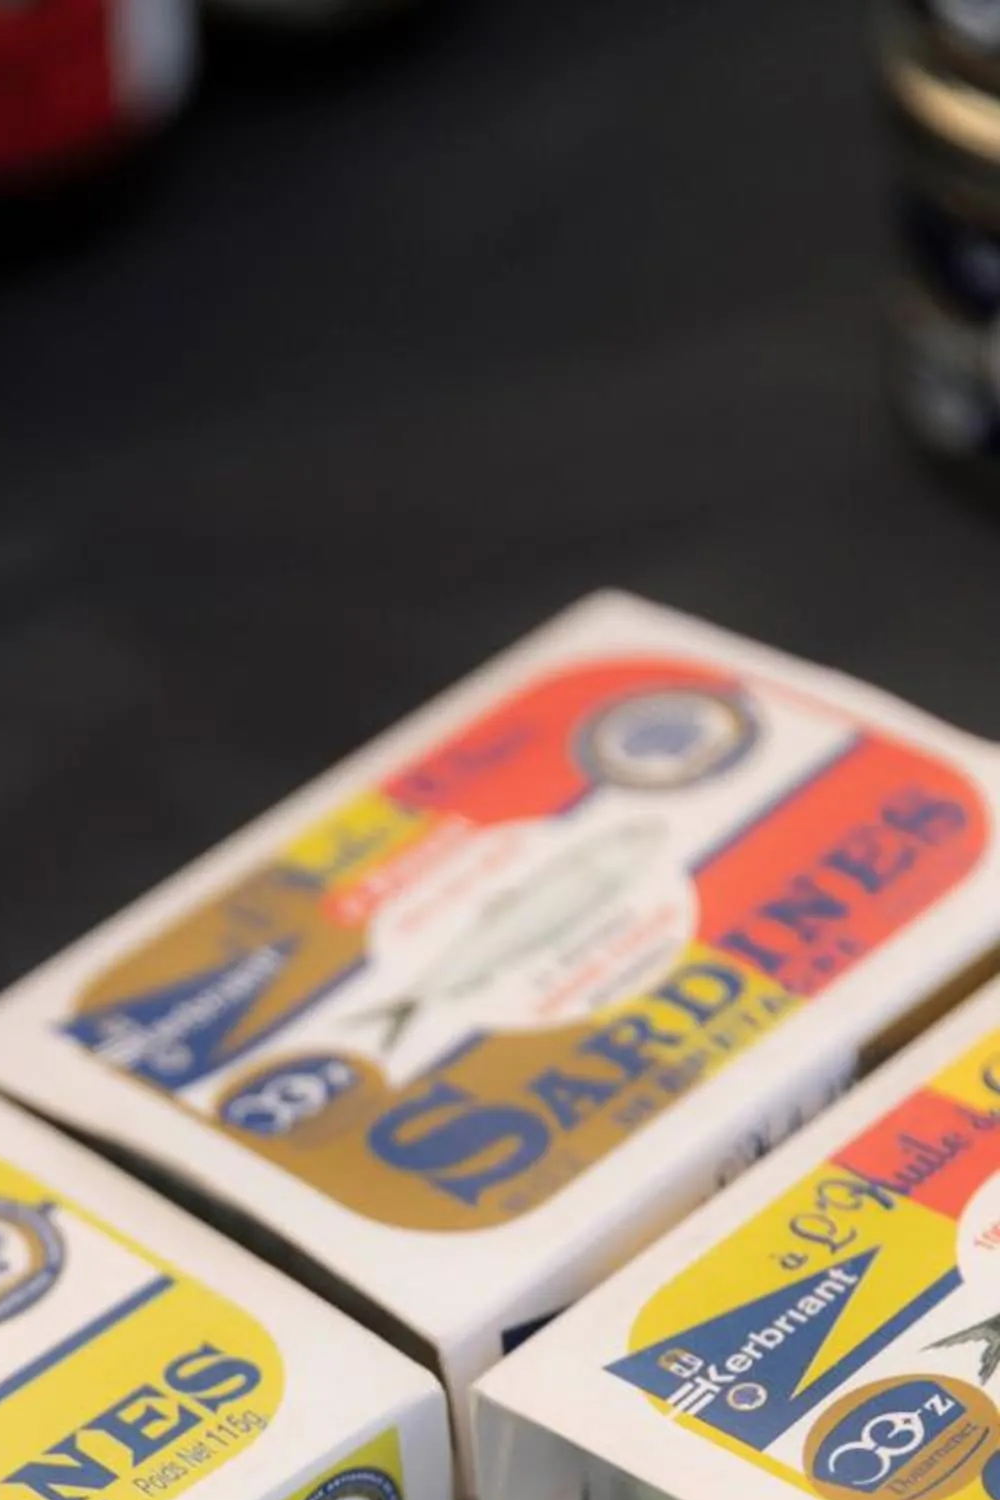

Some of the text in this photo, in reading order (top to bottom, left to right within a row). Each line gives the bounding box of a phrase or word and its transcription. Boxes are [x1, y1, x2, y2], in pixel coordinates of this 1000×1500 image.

[366, 781, 970, 1207] SARDINES
[690, 1266, 858, 1400] Kerbriant
[131, 1460, 190, 1498] Poids
[204, 1409, 269, 1447] 115g
